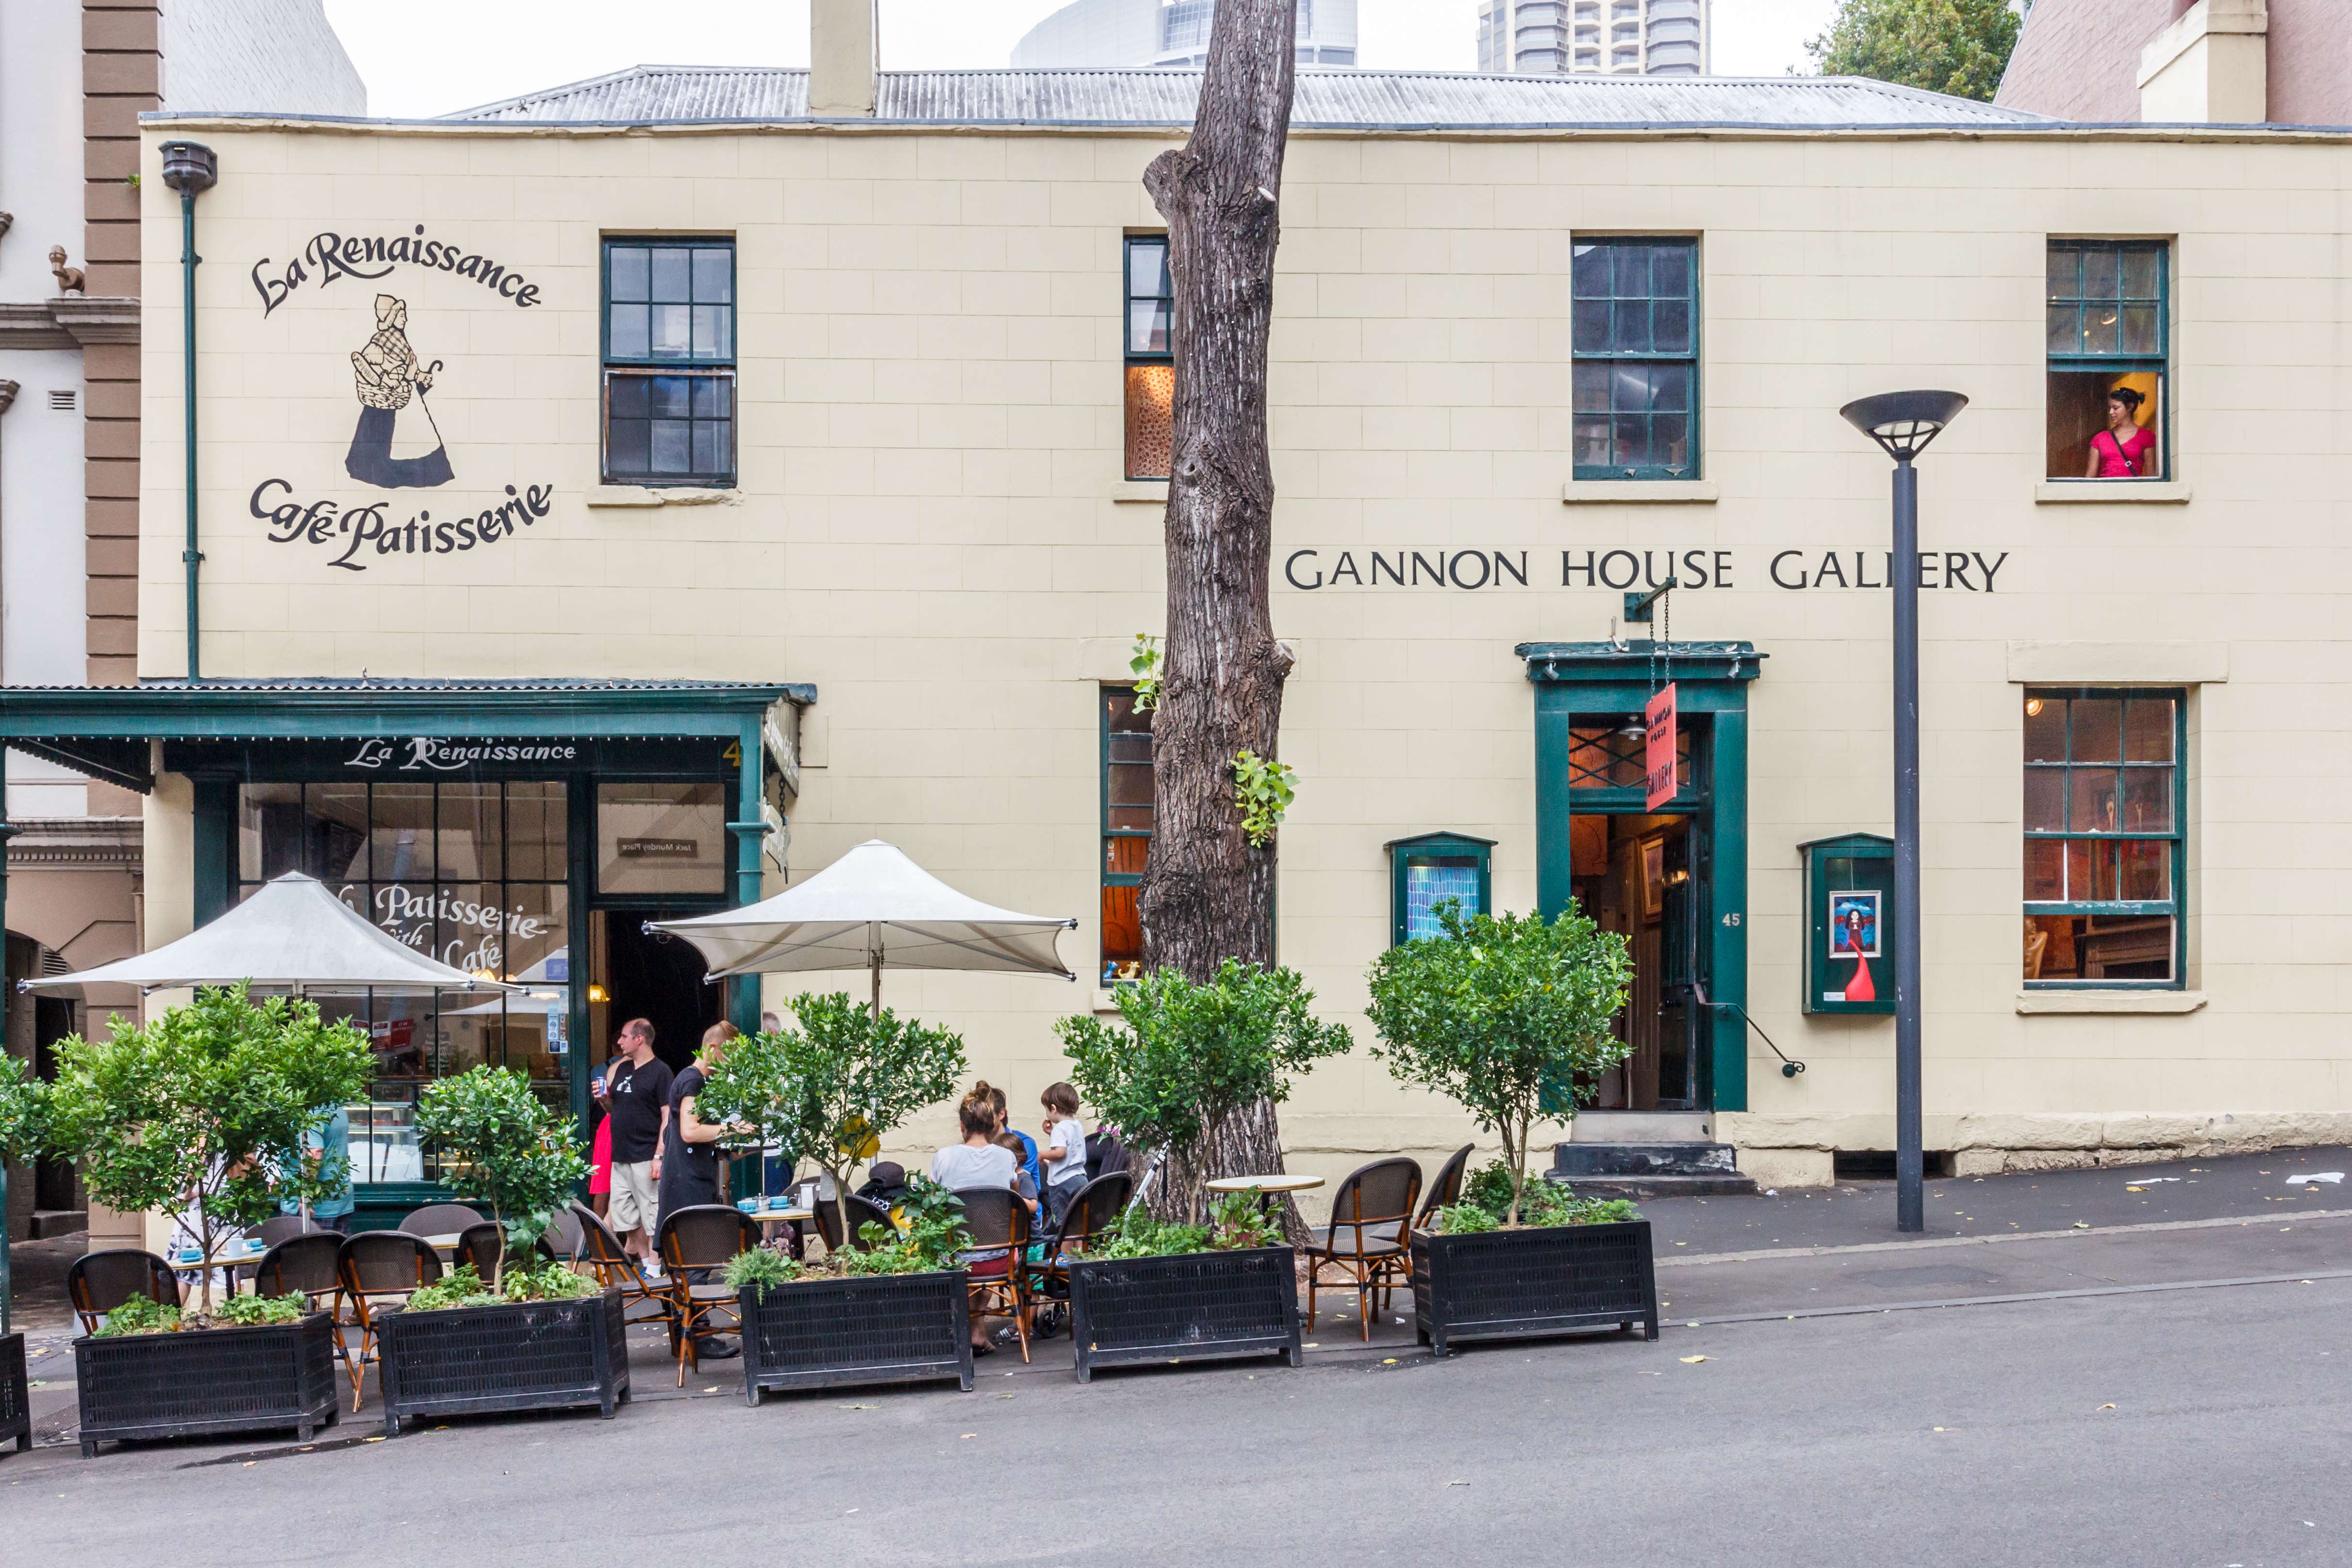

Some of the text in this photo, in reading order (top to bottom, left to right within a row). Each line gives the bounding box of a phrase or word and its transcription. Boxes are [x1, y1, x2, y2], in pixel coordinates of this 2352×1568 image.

[252, 224, 541, 319] La Renaissance
[250, 479, 553, 571] Café Patisserie
[1285, 550, 1528, 590] GANNON
[1562, 550, 1733, 589] HOUSE
[344, 737, 576, 770] La Renaissance
[375, 883, 548, 939] Patisserie
[1721, 913, 1740, 926] 45
[443, 934, 503, 971] Café
